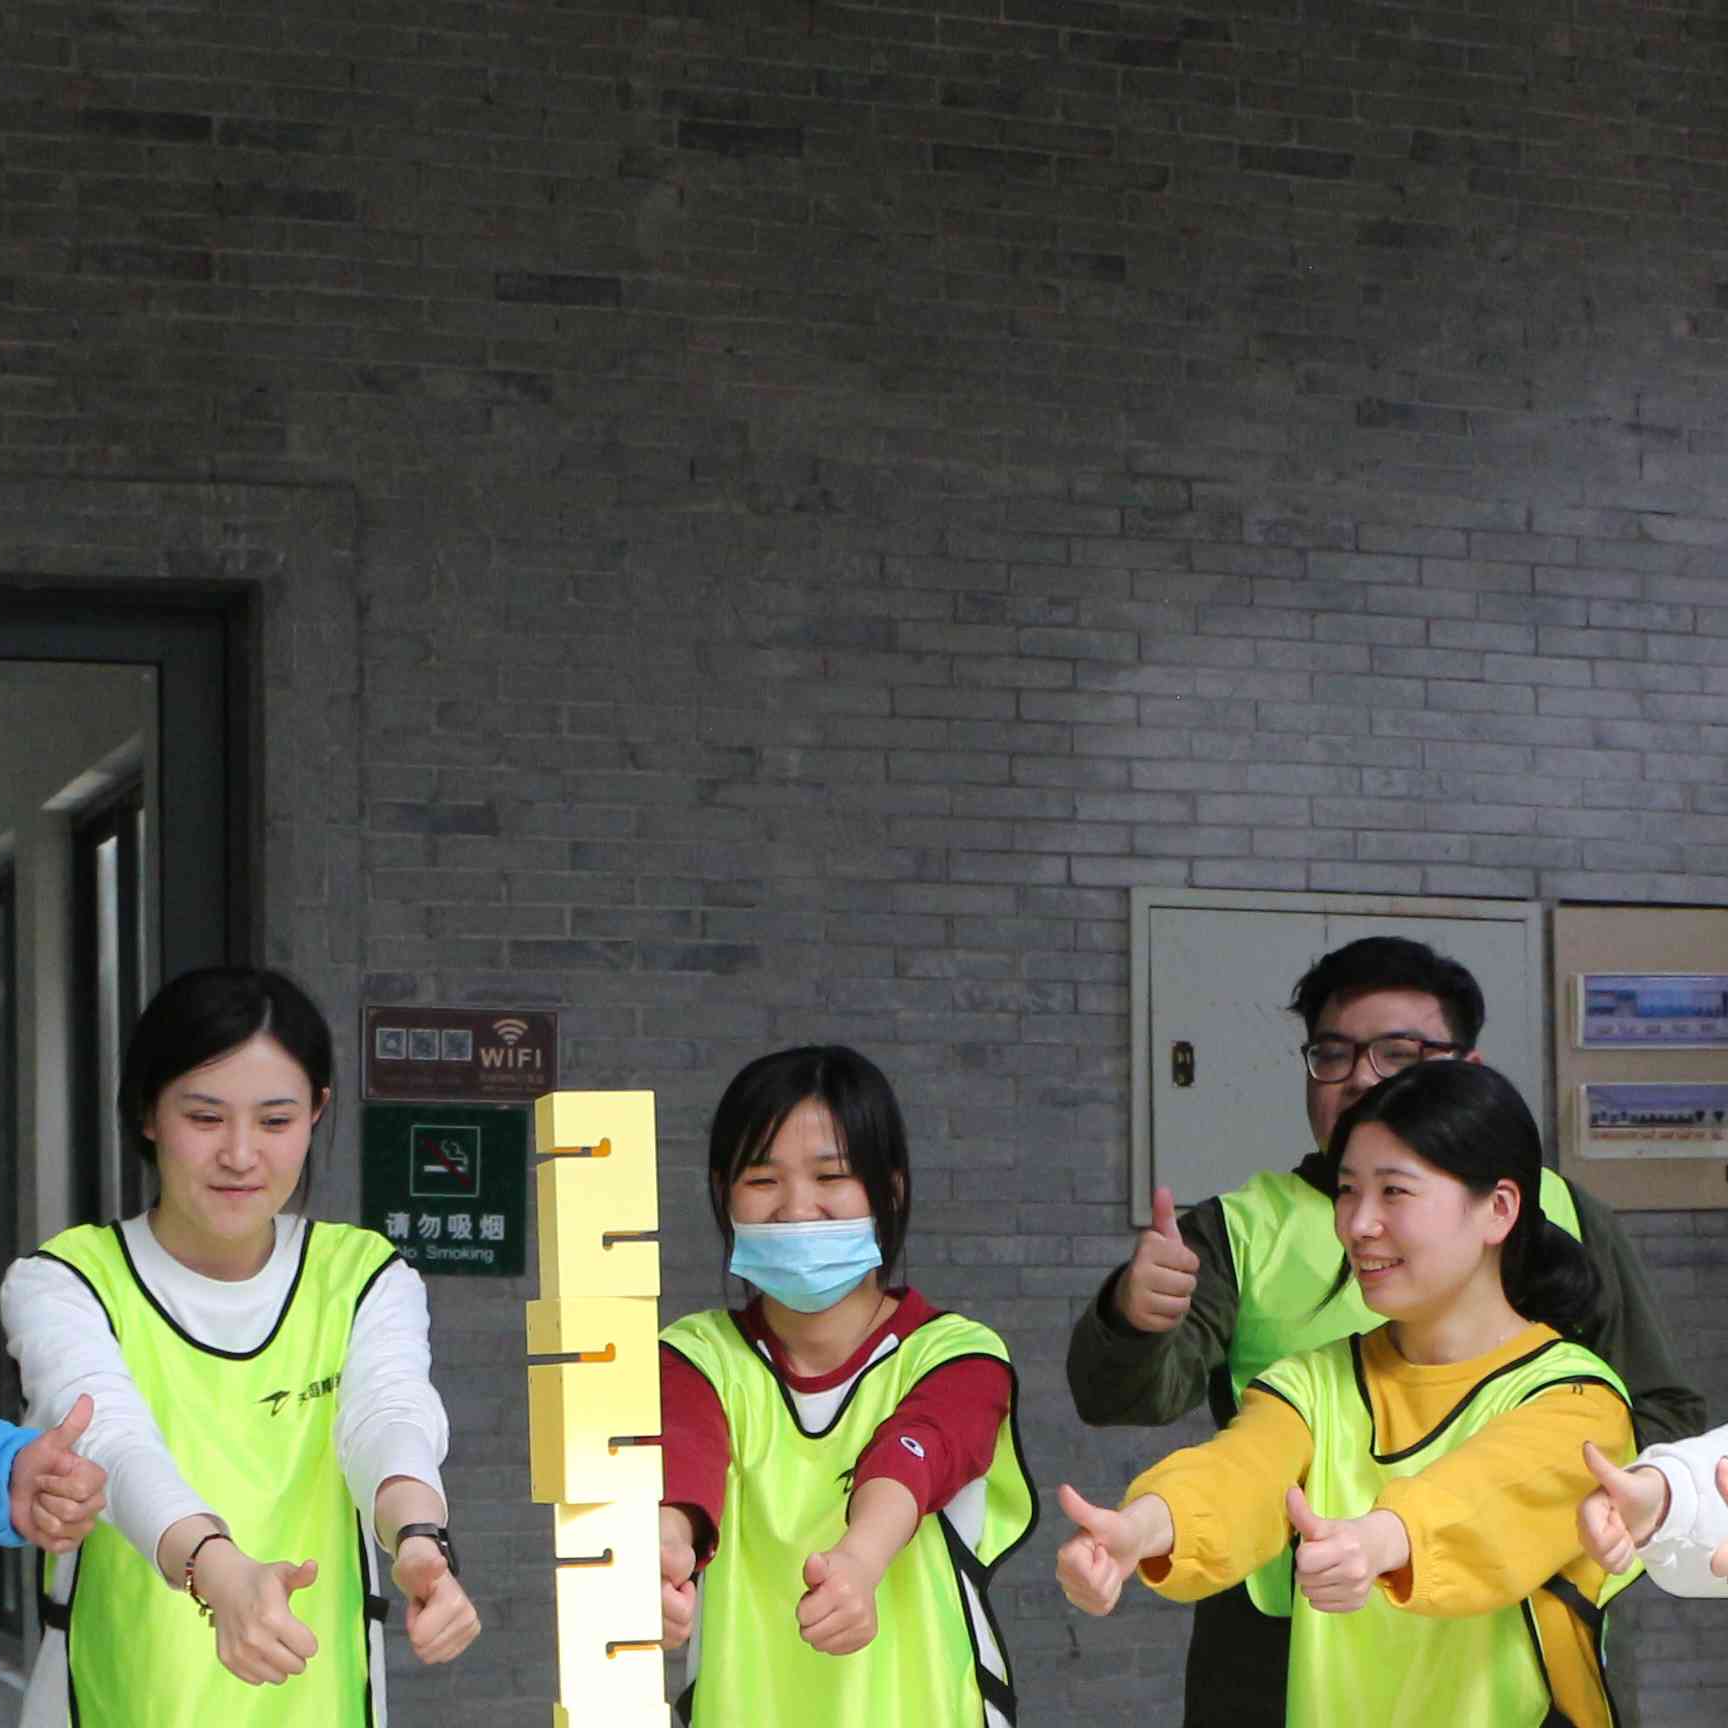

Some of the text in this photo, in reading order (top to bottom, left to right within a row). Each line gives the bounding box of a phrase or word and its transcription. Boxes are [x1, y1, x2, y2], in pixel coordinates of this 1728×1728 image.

[480, 1047, 543, 1069] WIFI
[385, 1211, 505, 1241] 请勿吸烟
[425, 1244, 495, 1264] Smoking
